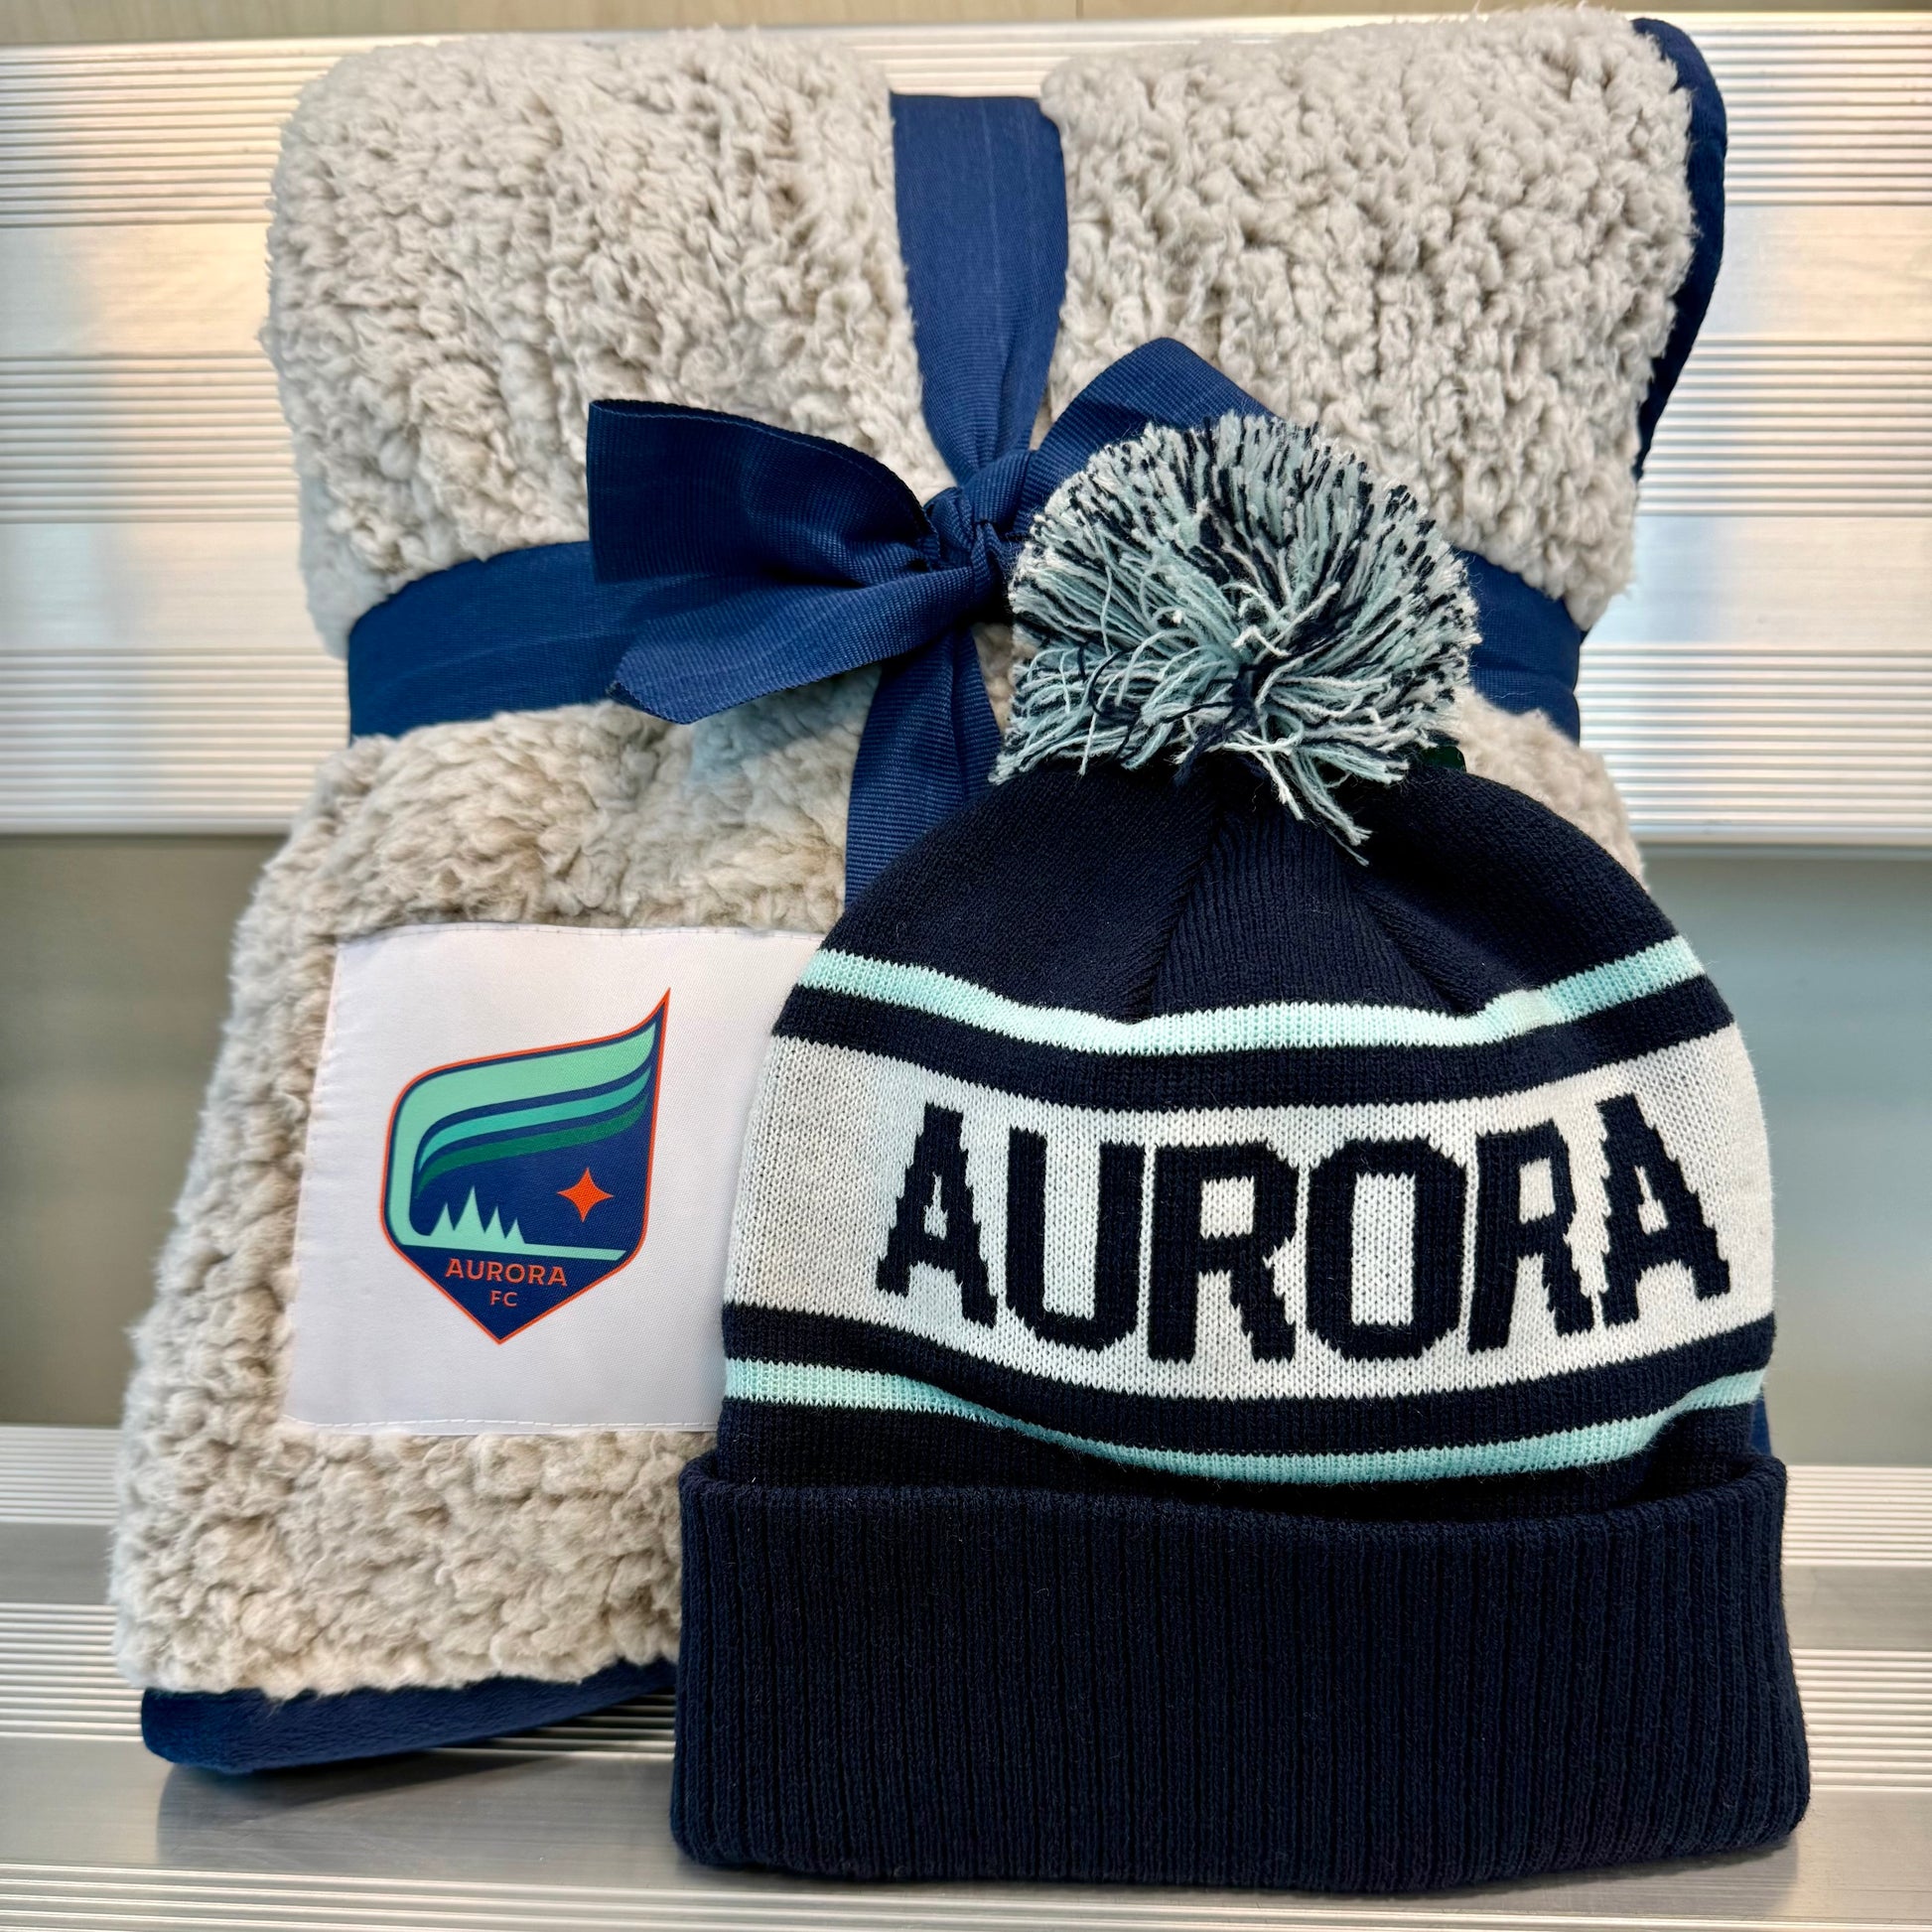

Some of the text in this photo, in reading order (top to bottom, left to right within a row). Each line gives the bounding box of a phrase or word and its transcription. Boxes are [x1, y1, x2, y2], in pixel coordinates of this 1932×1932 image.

[876, 1093, 1731, 1362] AURORA
[445, 1257, 568, 1287] AURORA
[489, 1290, 518, 1308] FC
